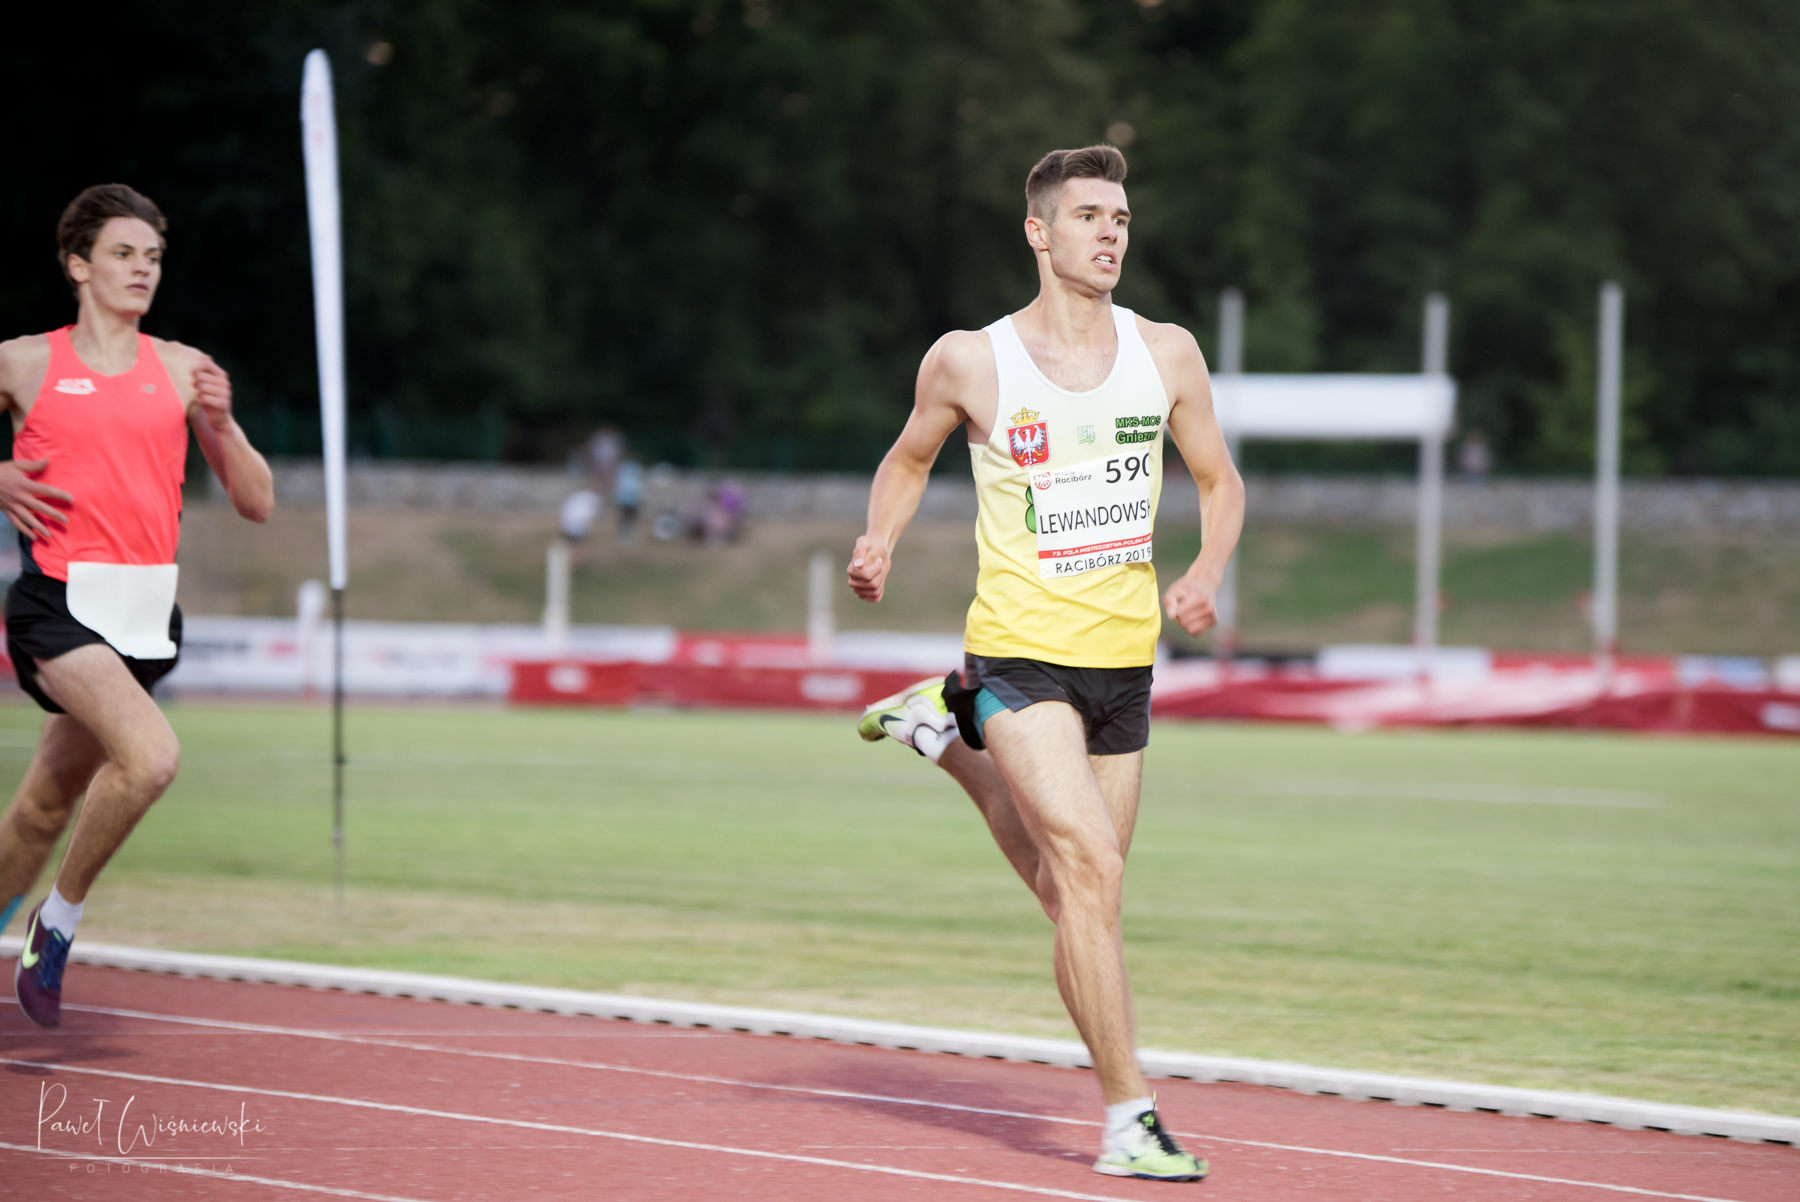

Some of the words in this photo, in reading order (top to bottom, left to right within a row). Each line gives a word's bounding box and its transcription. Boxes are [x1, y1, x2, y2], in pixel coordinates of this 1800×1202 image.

[1115, 415, 1161, 428] MKS-MOS
[1055, 474, 1092, 485] Racibórz
[1080, 542, 1122, 553] MISTRZOSTWA
[1056, 553, 1121, 574] RACIBÓRZ
[1125, 546, 1151, 563] 2019
